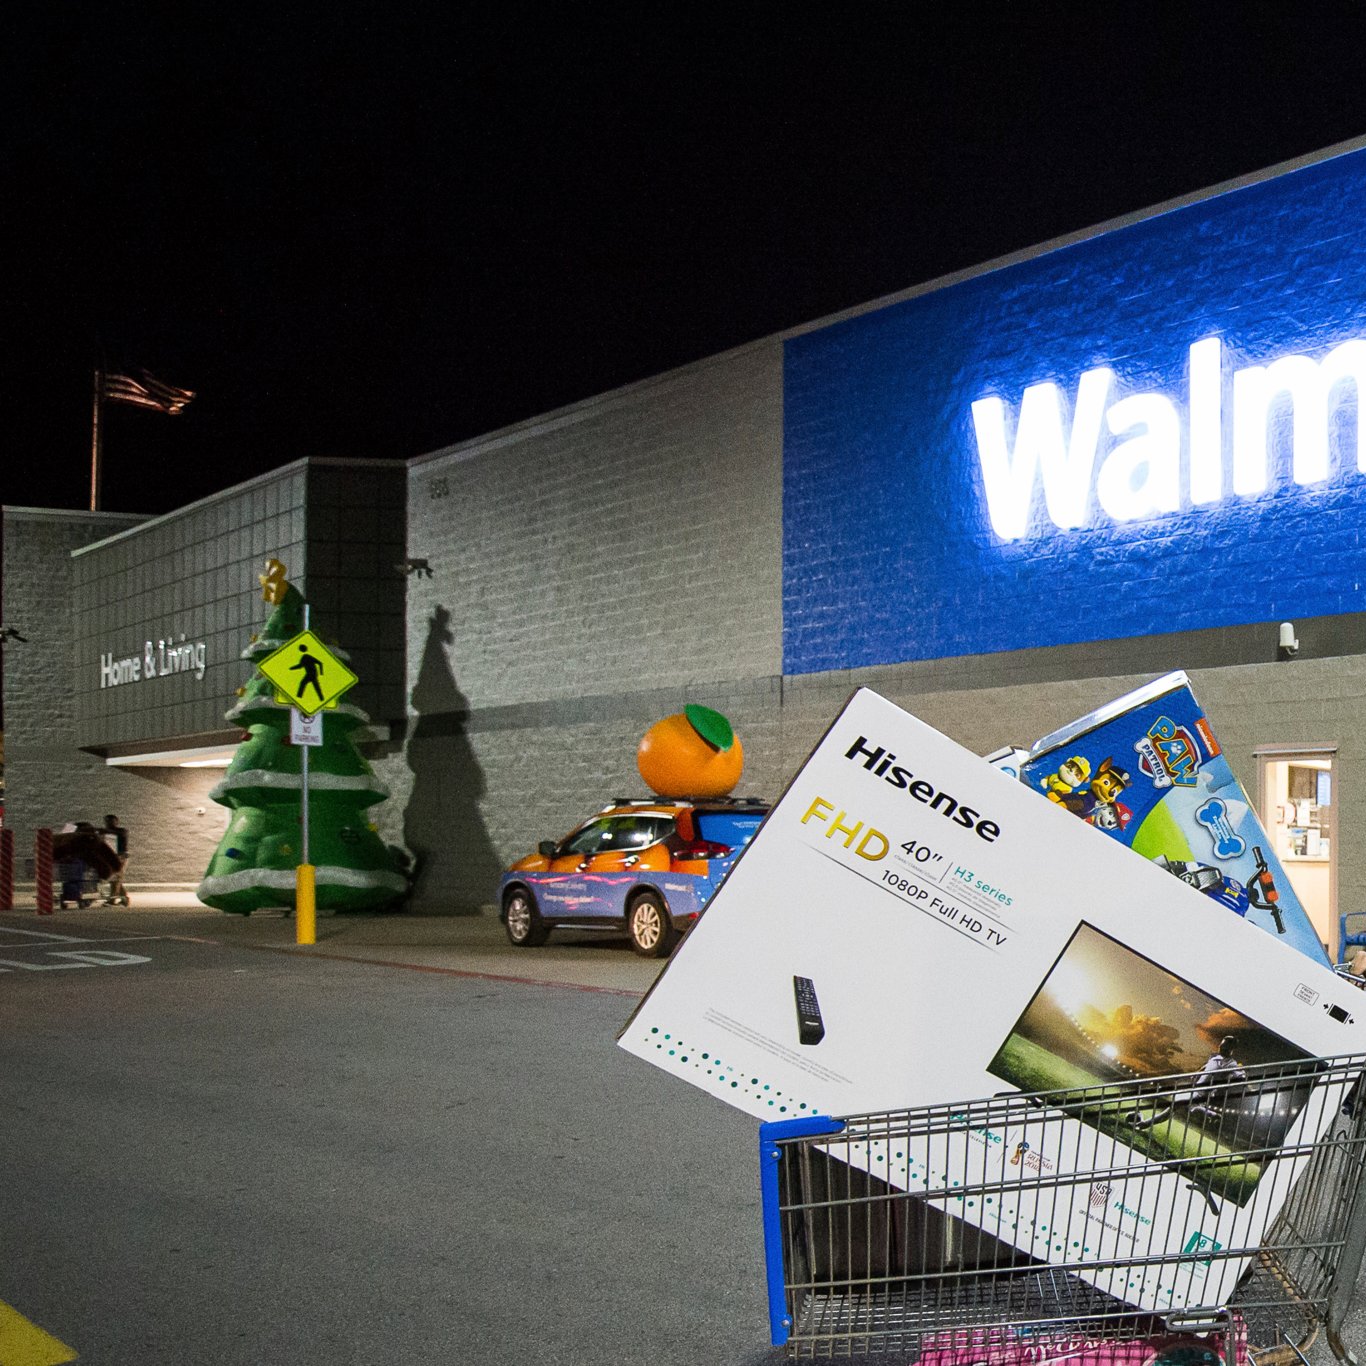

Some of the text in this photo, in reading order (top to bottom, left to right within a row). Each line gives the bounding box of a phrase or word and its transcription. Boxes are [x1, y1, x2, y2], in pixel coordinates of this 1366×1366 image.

[100, 633, 206, 689] Home & Living
[1141, 743, 1167, 783] PATROL
[1147, 715, 1198, 788] PAW
[844, 735, 1001, 843] Hisense
[800, 796, 891, 862] FHD
[881, 869, 929, 901] 1080P
[929, 897, 959, 920] Full
[958, 913, 983, 934] HD
[985, 928, 1007, 947] TV
[954, 865, 975, 883] H3
[974, 879, 1014, 907] series
[1113, 1200, 1152, 1226] Hsense
